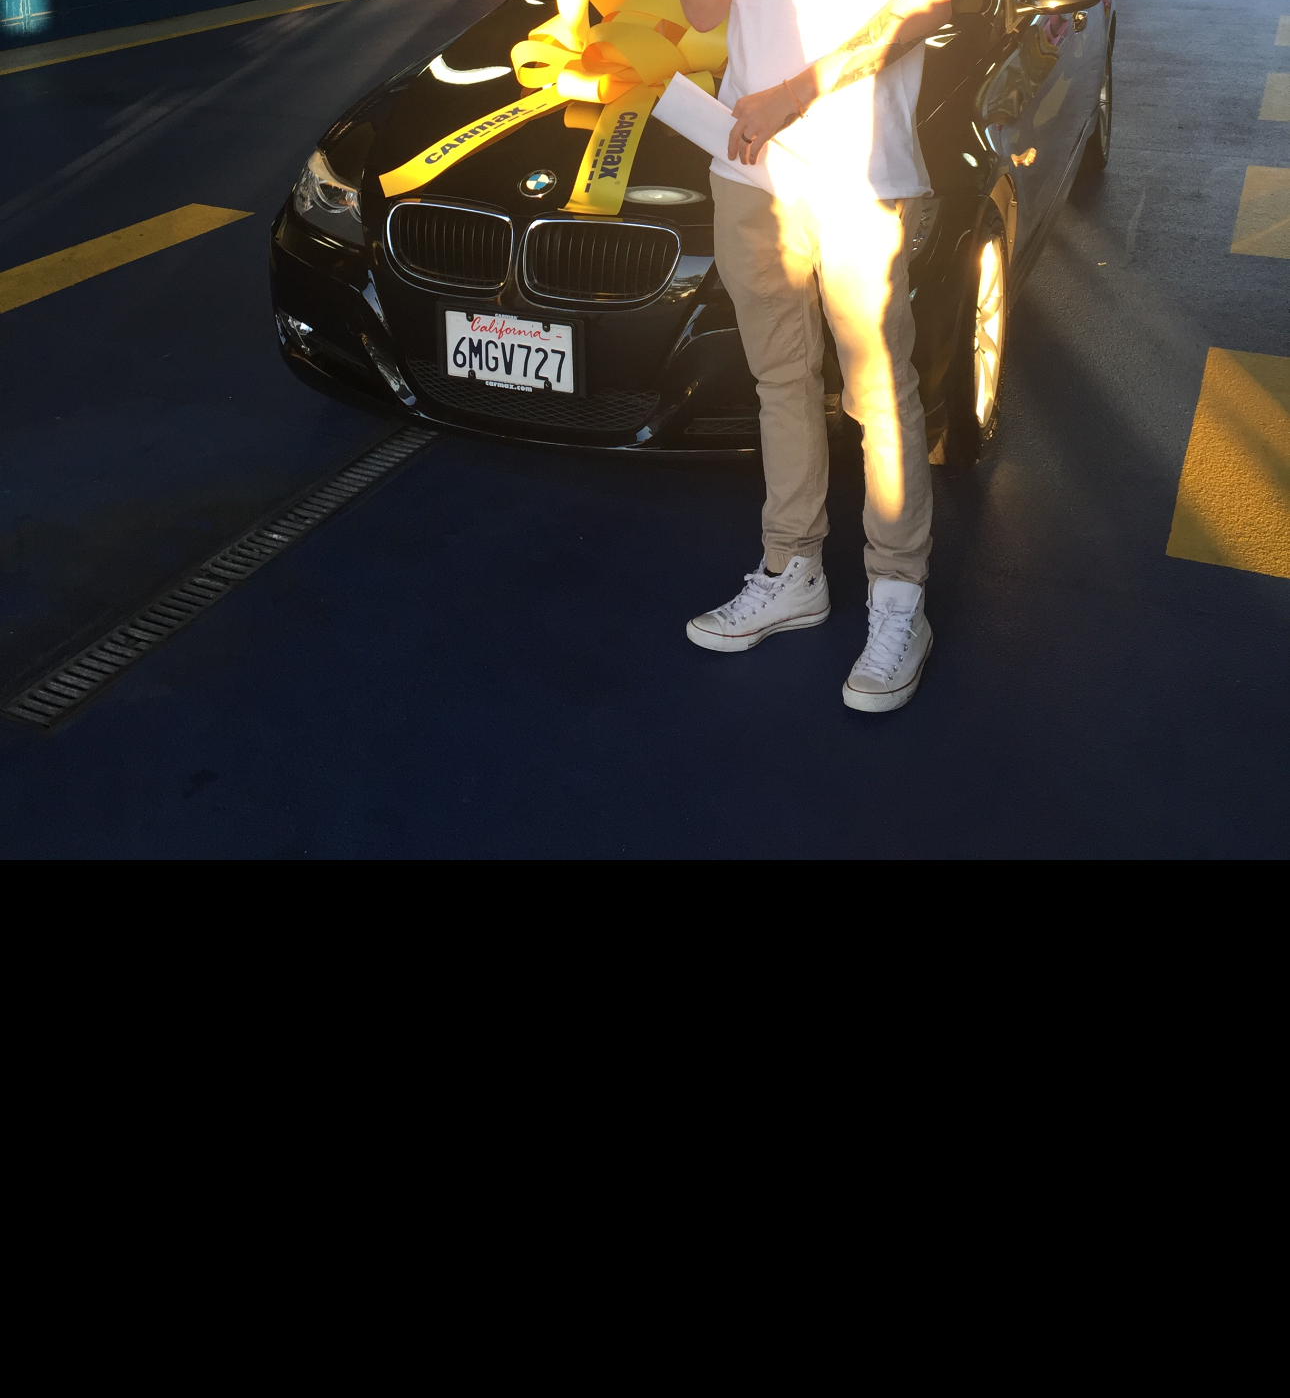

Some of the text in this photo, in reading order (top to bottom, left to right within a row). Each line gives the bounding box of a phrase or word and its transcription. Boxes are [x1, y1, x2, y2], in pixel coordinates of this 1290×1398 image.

[470, 316, 551, 341] California
[452, 336, 566, 383] 6MGV727
[484, 380, 533, 393] carmax.com
